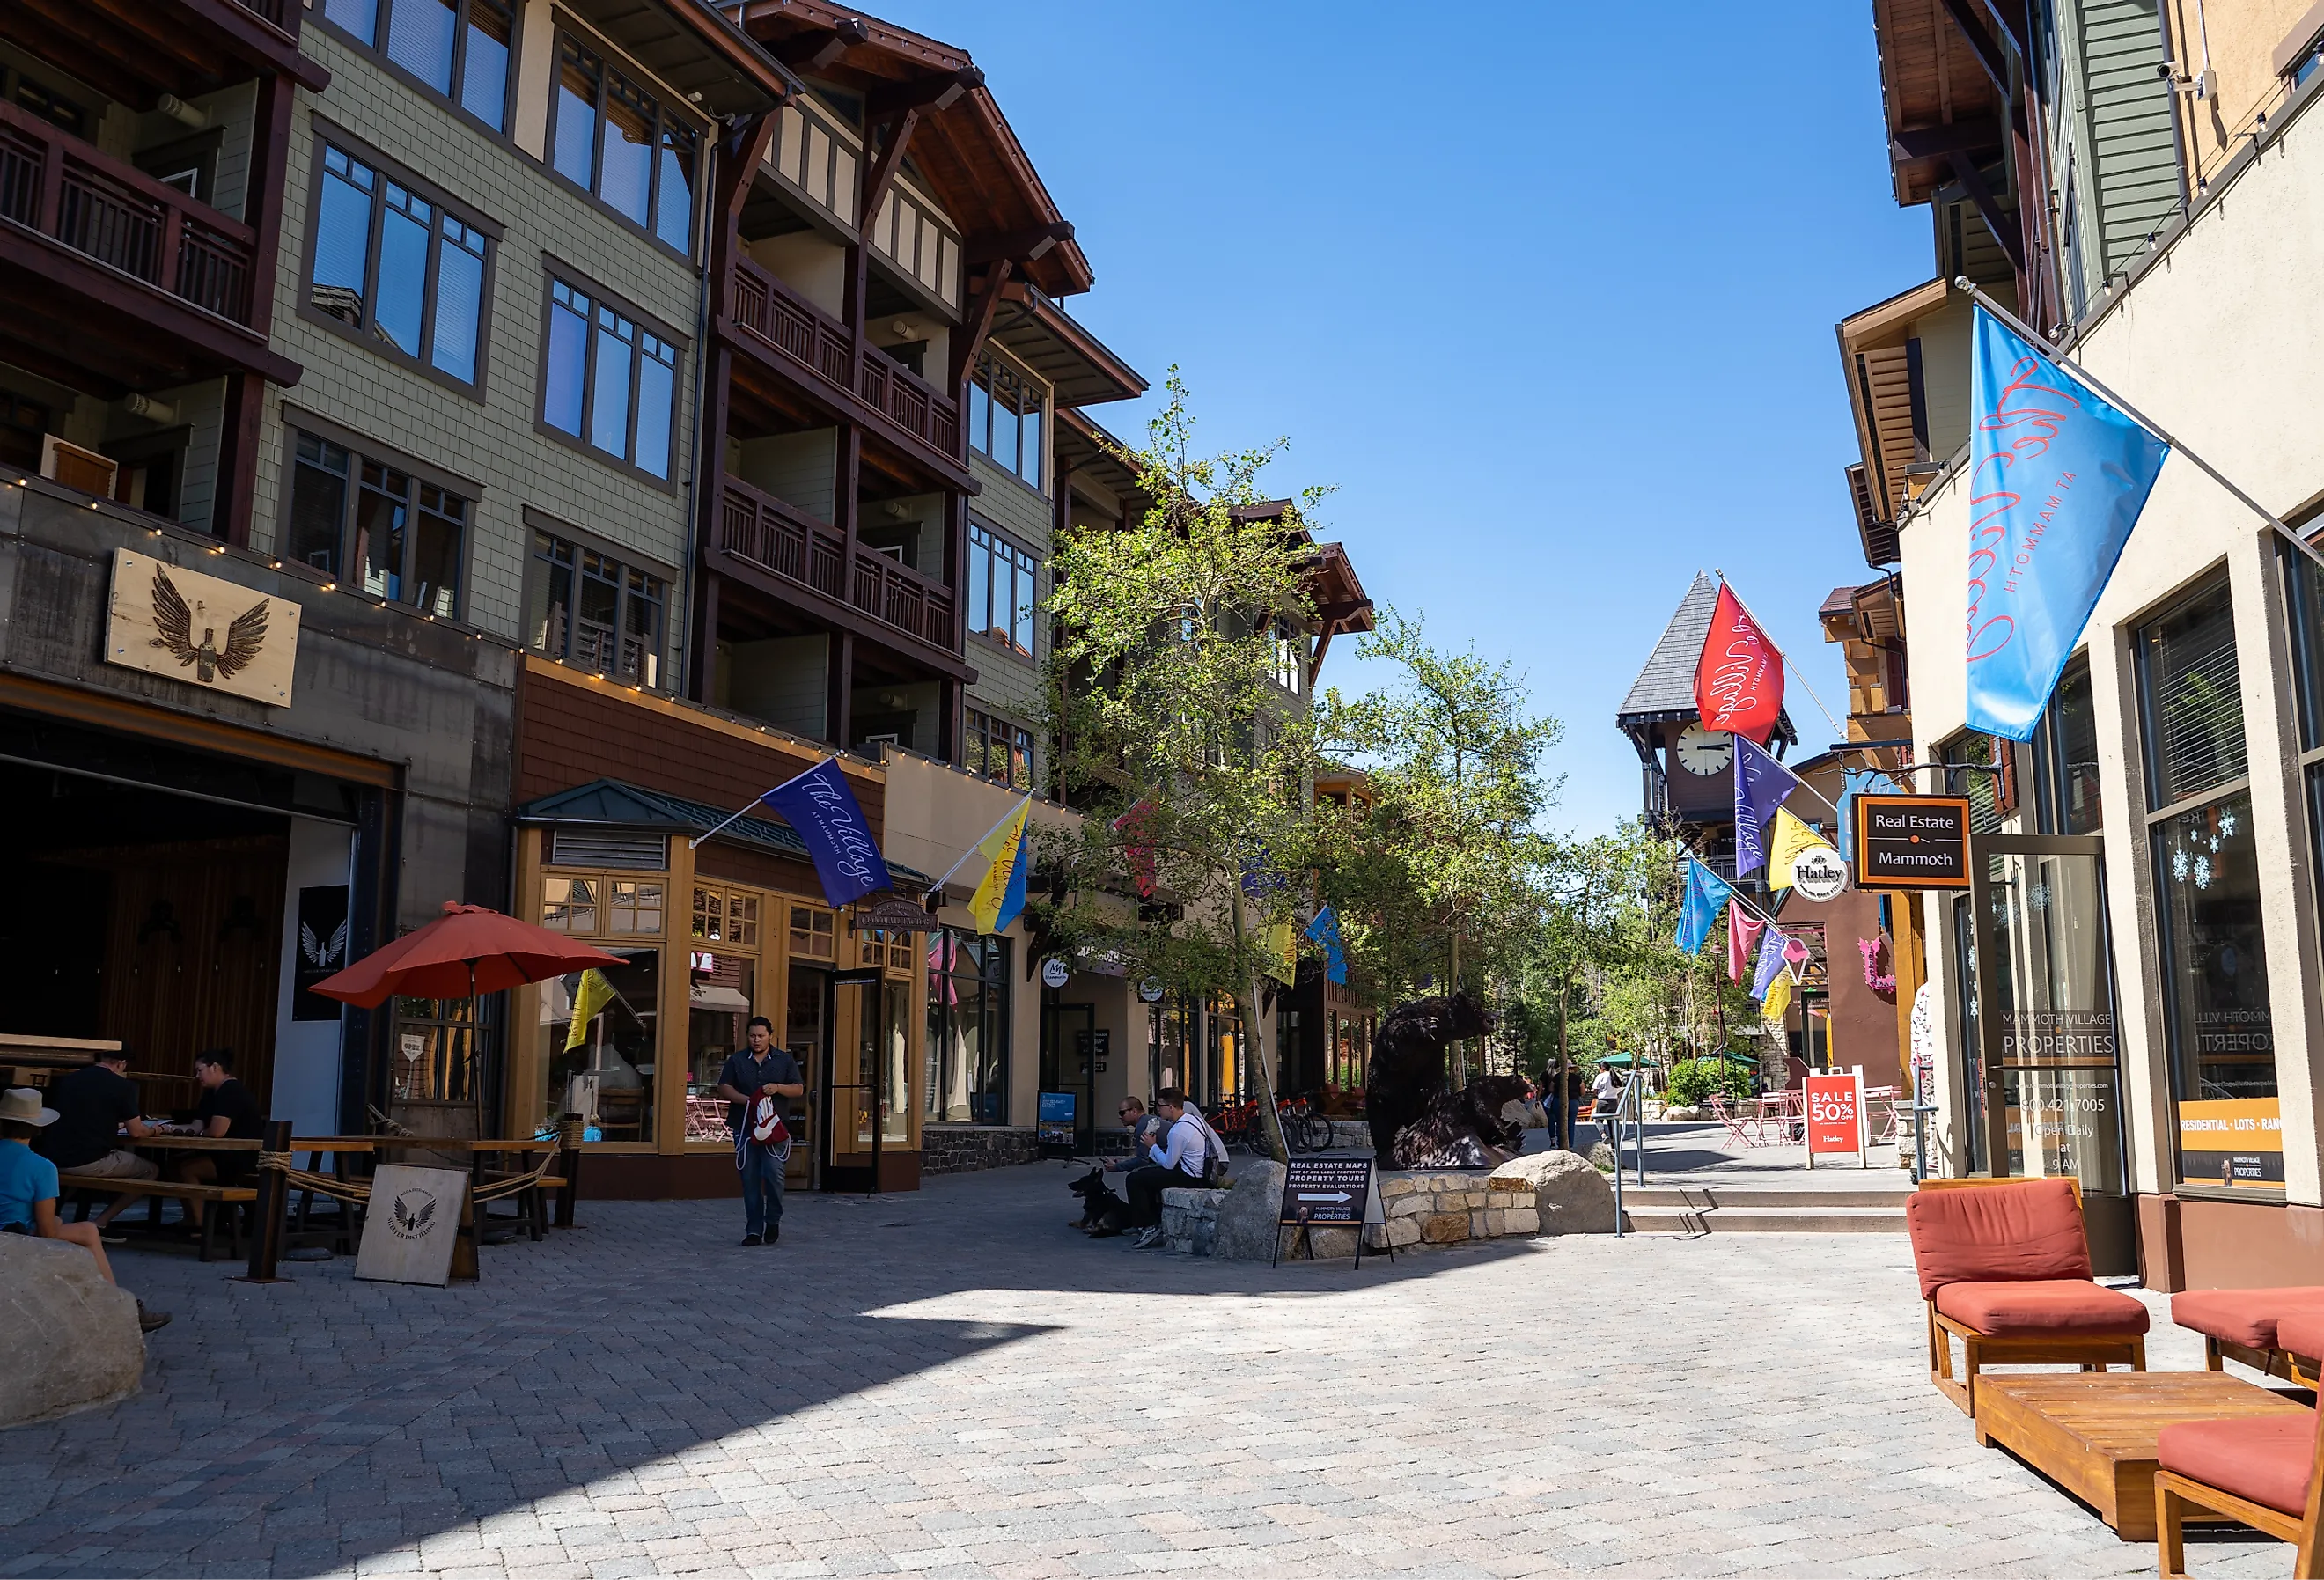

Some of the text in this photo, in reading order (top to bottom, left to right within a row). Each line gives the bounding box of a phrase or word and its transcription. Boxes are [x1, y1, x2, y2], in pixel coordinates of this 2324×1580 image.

[1876, 814, 1954, 829] Real Estate
[802, 772, 875, 886] The Village
[811, 811, 842, 856] AT MAMMOTH
[1879, 852, 1953, 866] Mammoth
[1796, 865, 1842, 882] Hatley
[2002, 1014, 2112, 1025] MAMMOTH VILLAGE
[2003, 1035, 2114, 1054] PROPERTIES
[1811, 1091, 1853, 1103] SALE
[1812, 1103, 1854, 1121] 50%
[2021, 1099, 2106, 1112] 800.421.7005
[2034, 1124, 2065, 1138] Open
[2067, 1123, 2094, 1138] Daily
[2181, 1118, 2229, 1131] RESIDENTIAL
[2233, 1118, 2255, 1130] LOTS
[2060, 1143, 2071, 1153] at
[2052, 1159, 2080, 1170] 9 AM
[2233, 1167, 2262, 1177] PROPERTIES
